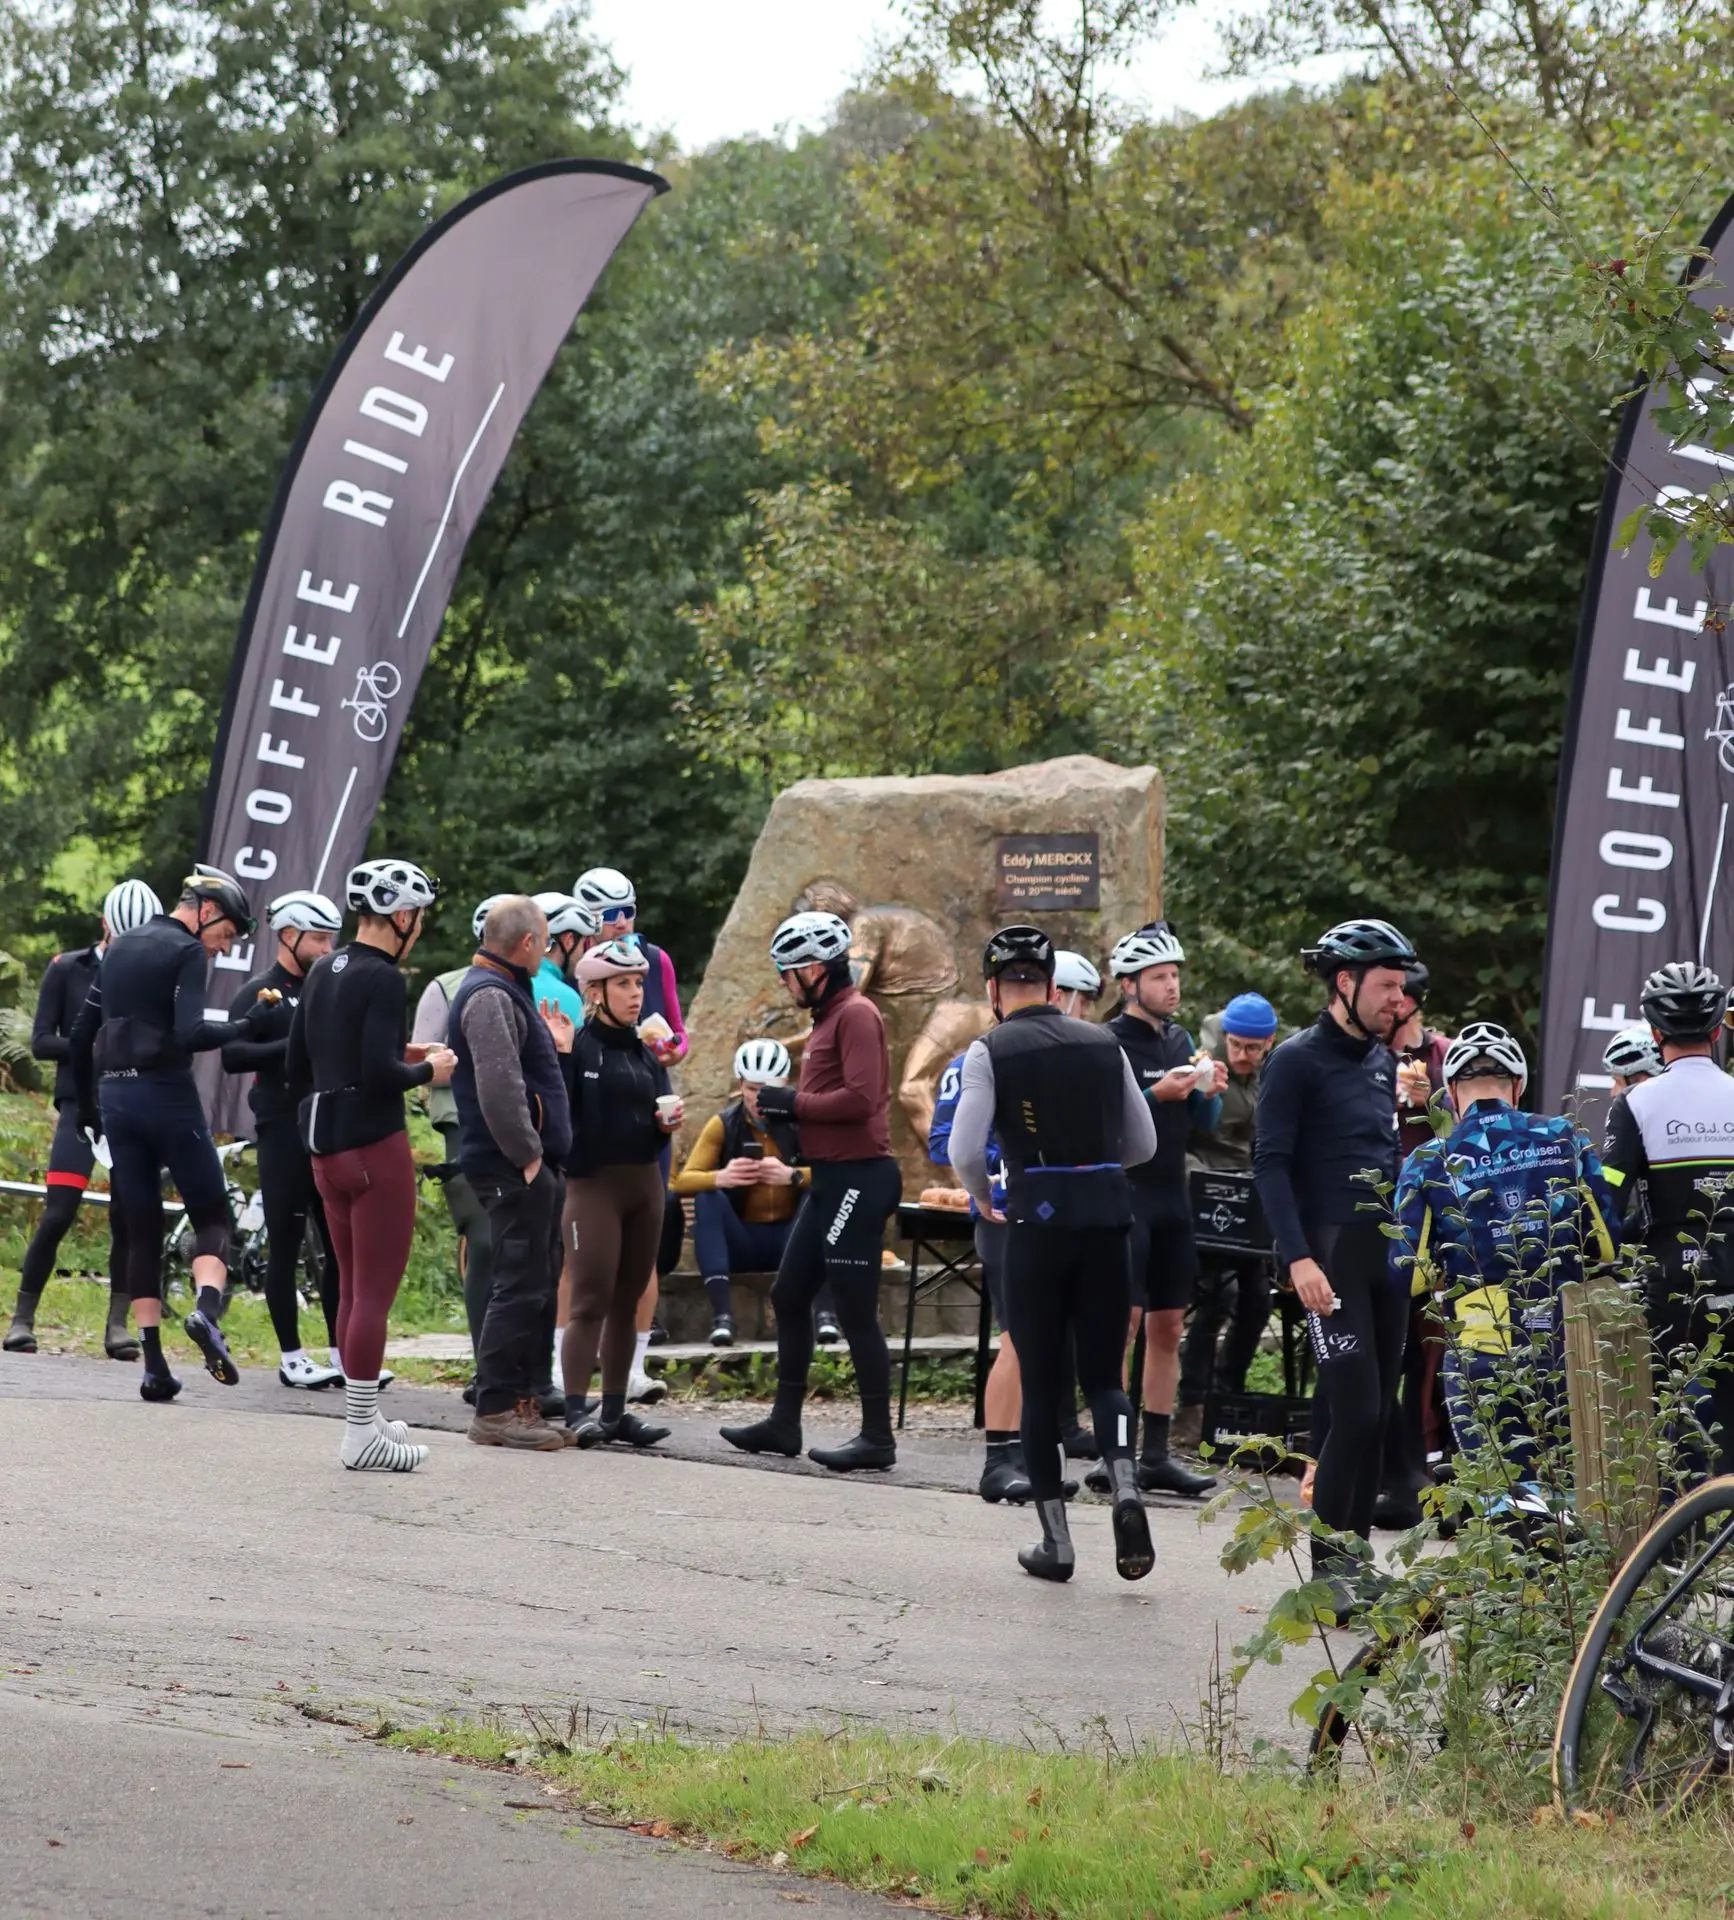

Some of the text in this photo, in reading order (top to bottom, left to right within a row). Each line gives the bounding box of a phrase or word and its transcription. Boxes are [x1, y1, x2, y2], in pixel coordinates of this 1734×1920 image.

[234, 570, 360, 881] COFFEE
[323, 331, 455, 528] RIDE
[1592, 587, 1708, 934] COFFEE
[1002, 852, 1093, 869] Eddy MERCKX
[1005, 874, 1052, 885] Champion
[1012, 886, 1026, 896] du
[1479, 1114, 1503, 1124] GOBIK
[1480, 1145, 1562, 1167] G.J. Crousen
[826, 1188, 861, 1246] ROBUSTA
